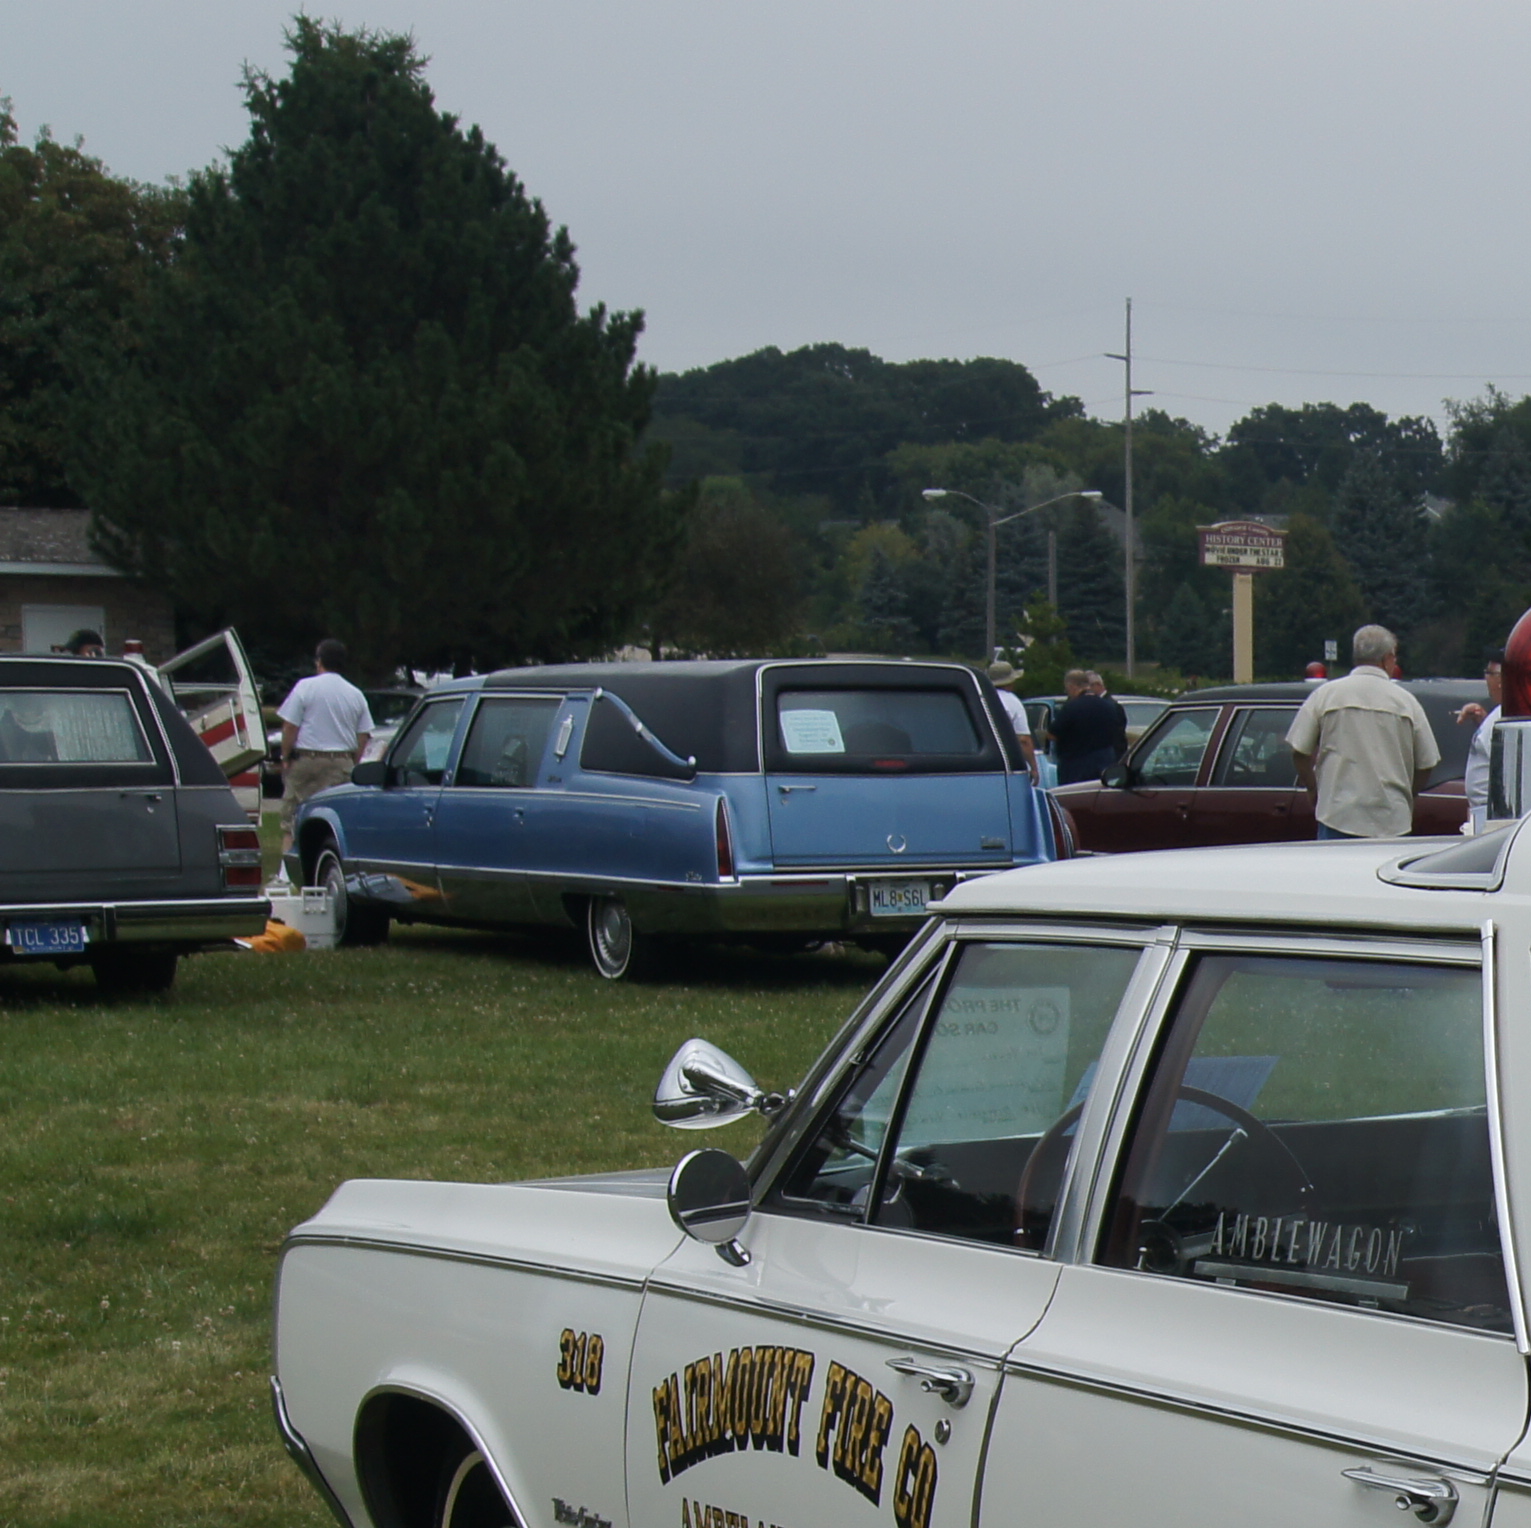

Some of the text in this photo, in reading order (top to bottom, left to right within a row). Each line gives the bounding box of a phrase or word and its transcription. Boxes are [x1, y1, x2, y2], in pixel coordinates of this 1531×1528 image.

[1205, 534, 1282, 547] HISTORY CENTER
[15, 927, 79, 946] TCL 335
[1209, 1211, 1403, 1276] AMBLEWAGON
[557, 1328, 604, 1395] 318
[652, 1345, 815, 1485] FAIRMOUNT
[815, 1360, 894, 1508] FIRE
